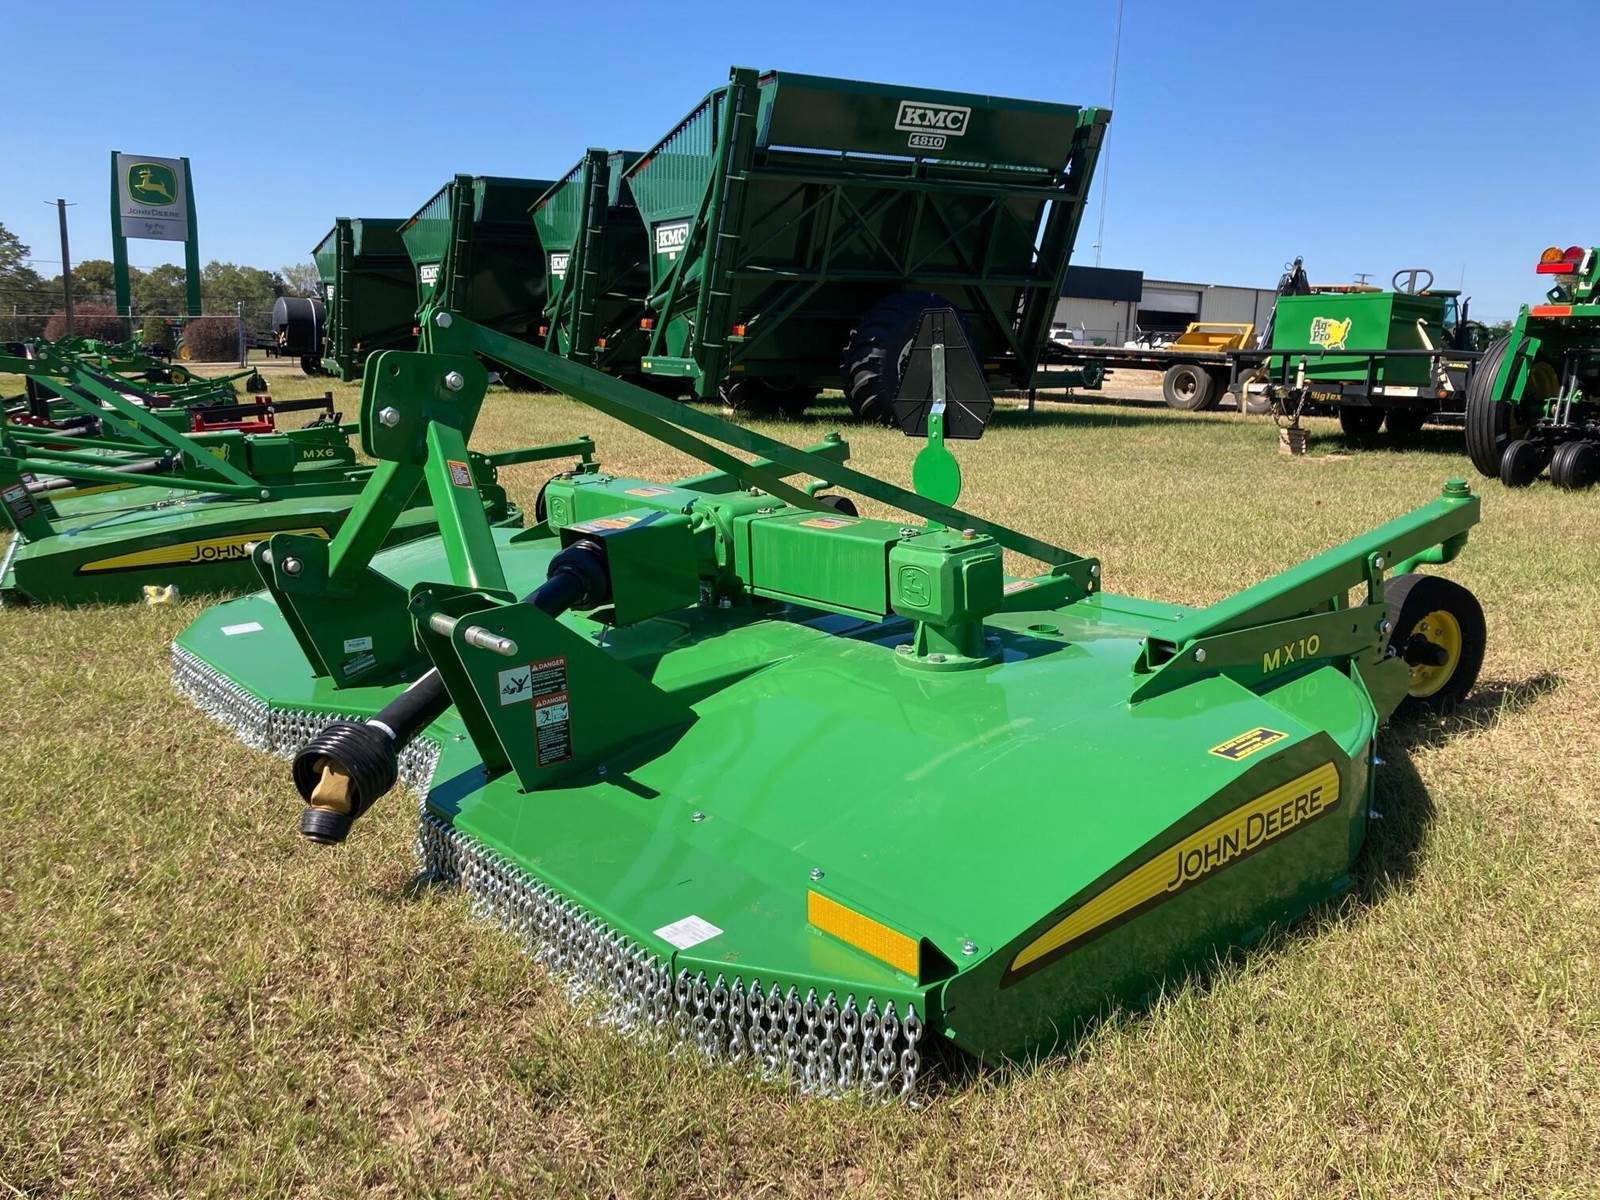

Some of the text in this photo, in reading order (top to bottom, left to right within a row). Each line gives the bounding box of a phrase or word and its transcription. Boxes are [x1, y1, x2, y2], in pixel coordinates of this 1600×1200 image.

[902, 107, 964, 129] KMC
[911, 136, 943, 147] 4810
[127, 207, 180, 217] JOHN DEERE
[659, 228, 687, 247] KMC
[1313, 319, 1332, 332] Ag-
[1312, 330, 1331, 341] Pro
[303, 448, 335, 458] MX6
[190, 544, 246, 561] JOHN
[1263, 634, 1320, 673] MX10
[538, 659, 565, 670] DANGER
[542, 695, 568, 706] DANGER
[1168, 786, 1323, 889] JOHN DEERE
